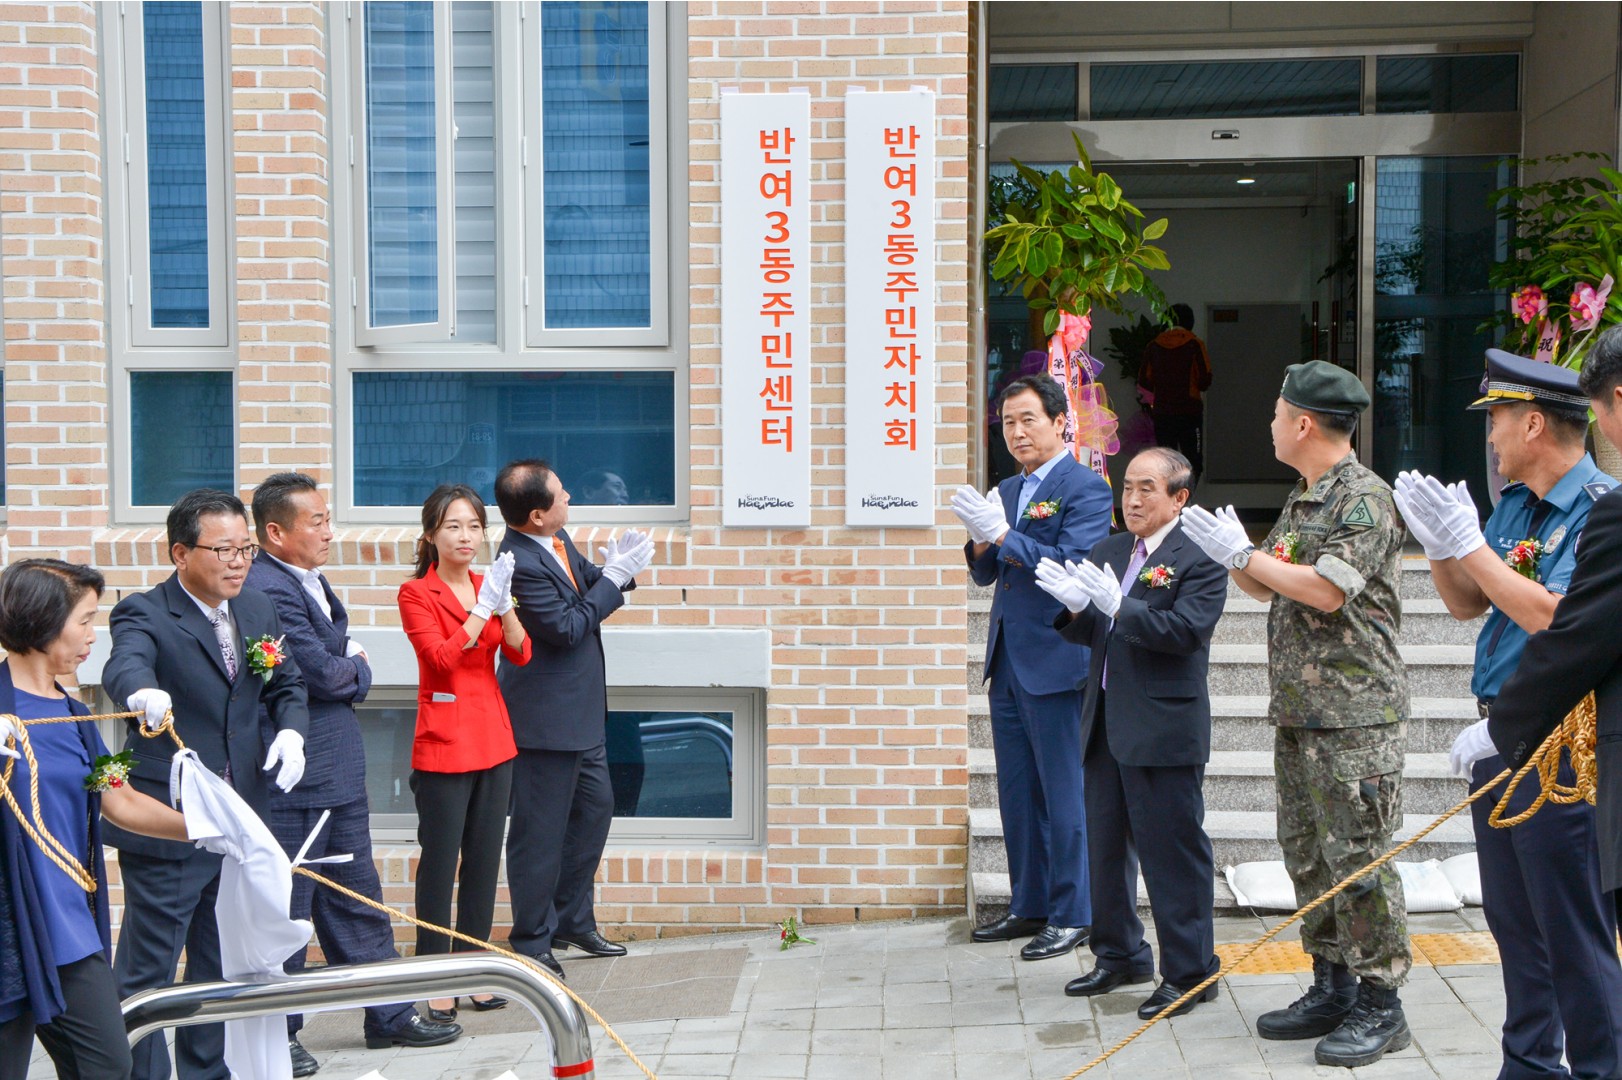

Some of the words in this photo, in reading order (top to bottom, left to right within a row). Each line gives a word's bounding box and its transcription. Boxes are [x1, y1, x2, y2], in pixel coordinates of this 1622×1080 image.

[759, 127, 796, 453] 반여3동주민센터
[883, 125, 921, 451] 반여3동주민자치회
[738, 497, 795, 510] Haeundae
[861, 497, 919, 510] Haeundae
